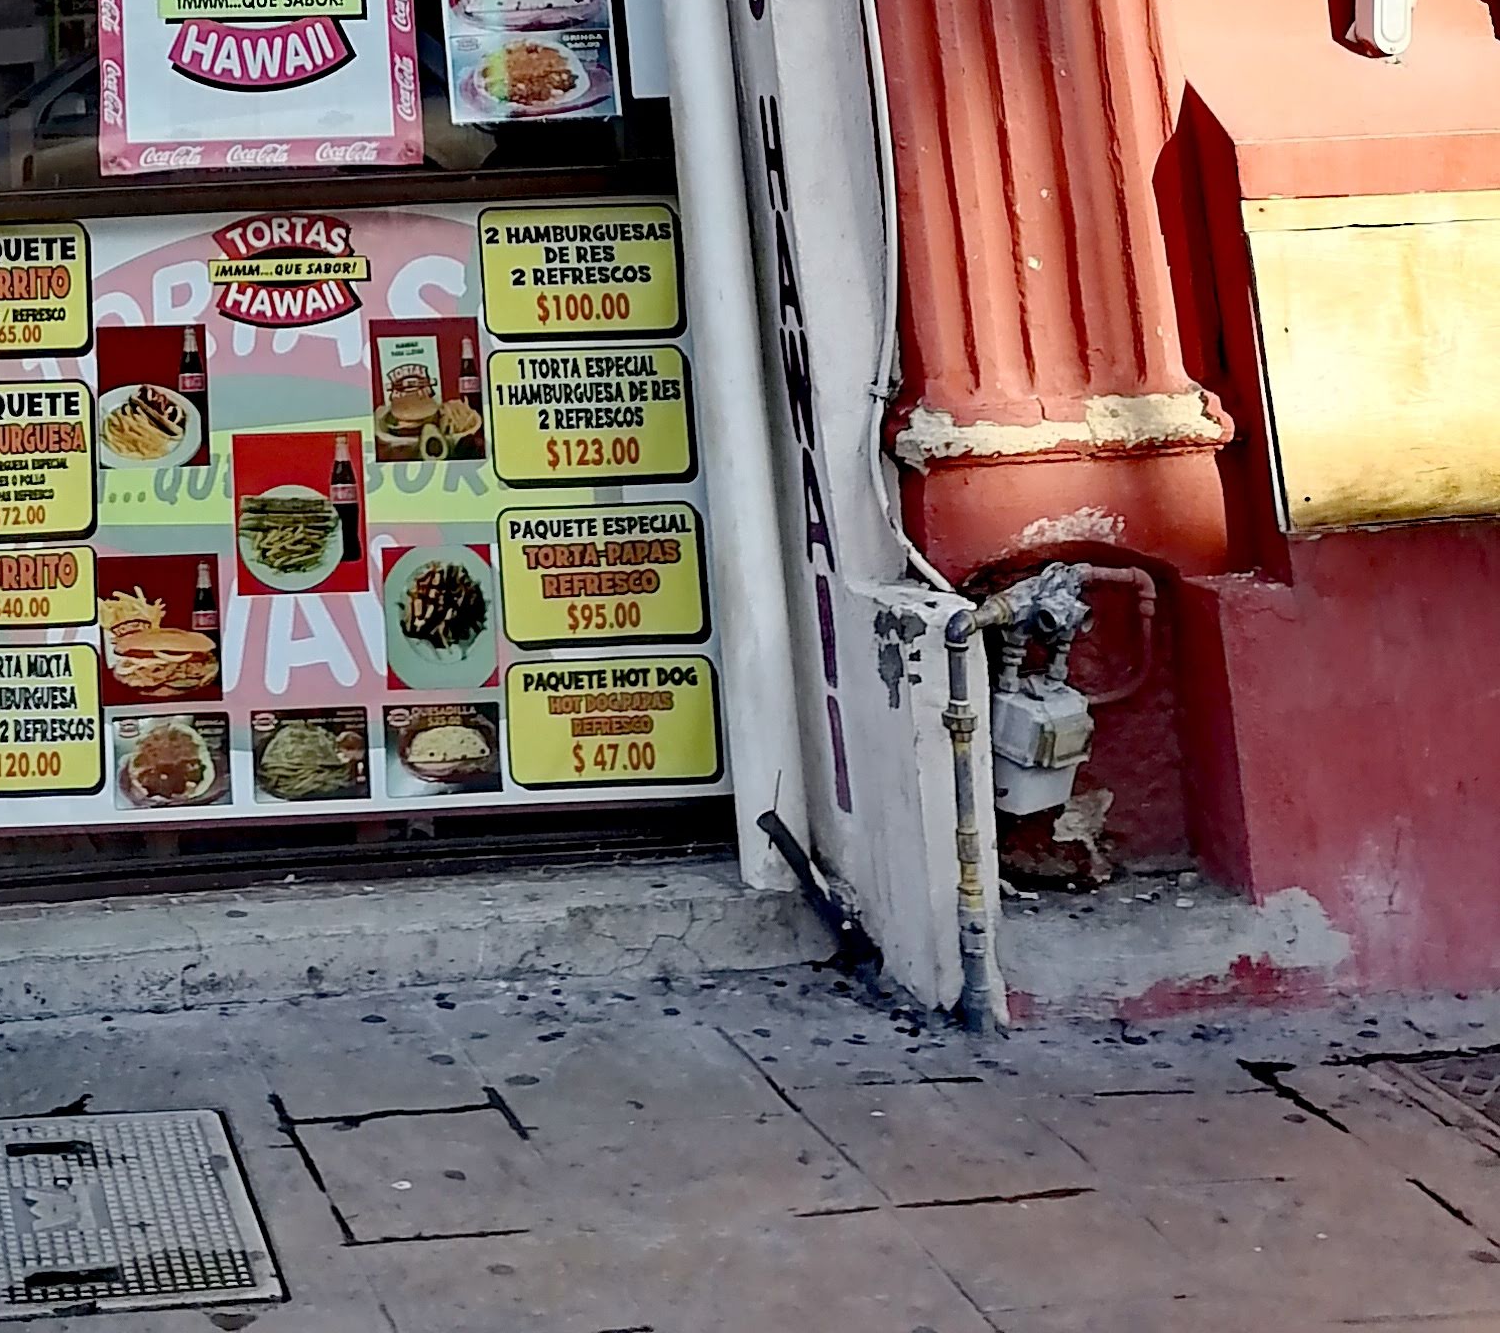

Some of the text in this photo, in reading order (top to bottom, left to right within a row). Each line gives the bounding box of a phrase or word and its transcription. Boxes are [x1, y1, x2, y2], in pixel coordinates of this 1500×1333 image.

[181, 23, 335, 80] HAWAII
[226, 217, 347, 255] TORTAS
[484, 222, 672, 245] 2 HAMBURGUESAS
[544, 246, 615, 264] DE RES
[306, 262, 357, 274] SABOR!
[510, 265, 652, 286] 2 REFRESCOS
[225, 280, 345, 318] HAWAII
[536, 291, 630, 325] $100.00
[12, 306, 66, 323] REFRESCO
[517, 355, 657, 380] 1 TORTA ESPECIAL
[496, 380, 681, 406] 1 HAMBURGUESA DE RES
[538, 407, 644, 430] 2 REFRESCOS
[546, 436, 640, 471] $123.00
[759, 95, 853, 813] HAWAII
[19, 473, 45, 486] POLLO
[508, 514, 692, 540] PAQUETE ESPECIAL
[522, 538, 681, 570] TORTA-PAPAS
[541, 570, 660, 599] REFRESCO
[567, 601, 641, 633] $95.00
[26, 654, 72, 677] MIXTA
[523, 666, 698, 692] PAQUETE HOT DOG
[411, 706, 477, 717] QUESADILLA
[548, 694, 582, 715] HOT
[0, 719, 9, 743] 2
[13, 718, 95, 743] REFRESCOS
[571, 715, 654, 738] REFRESCO
[593, 741, 656, 771] 47.00
